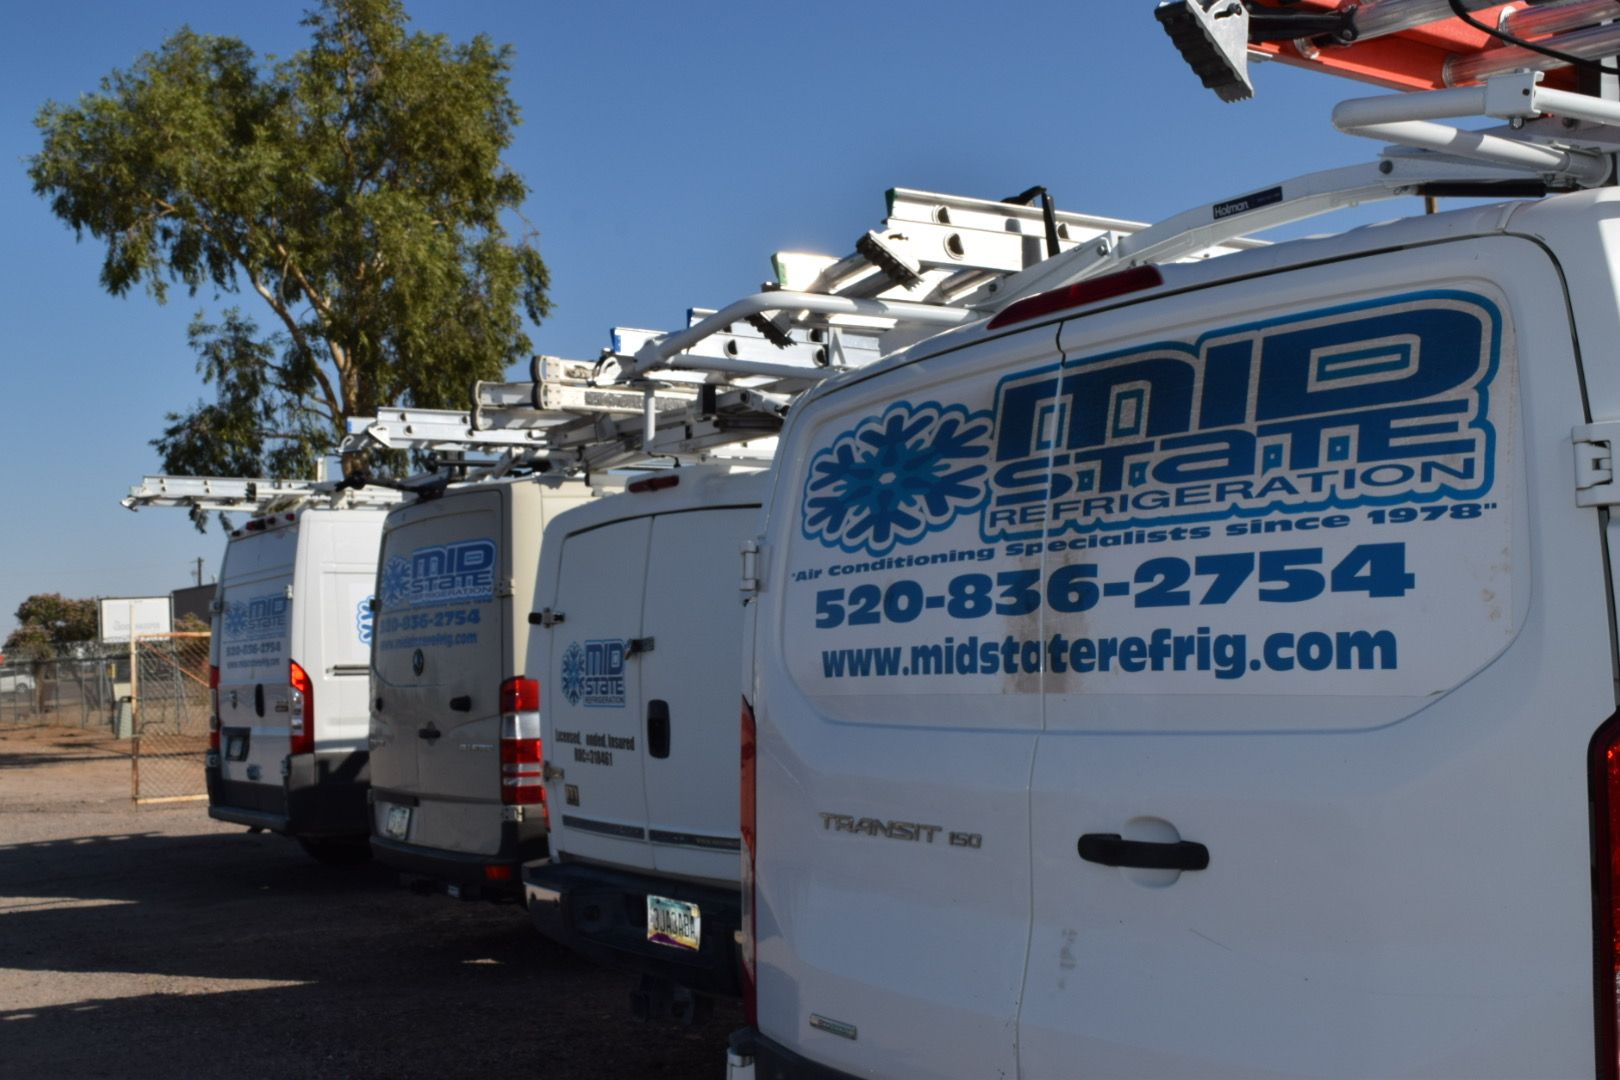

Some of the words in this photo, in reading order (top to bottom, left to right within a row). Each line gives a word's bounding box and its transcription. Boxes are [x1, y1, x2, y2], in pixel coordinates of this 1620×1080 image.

[1214, 201, 1250, 218] Holman
[988, 457, 1475, 529] REFRIGERATION
[828, 547, 996, 577] Conditioning
[1005, 526, 1212, 557] Specialists
[1225, 514, 1351, 537] since
[1366, 502, 1498, 526] 1978"
[814, 541, 1416, 630] 520-836-2754
[821, 626, 1398, 680] www.midstaterefrig.com
[817, 811, 943, 843] TRANSIT
[948, 830, 983, 849] 150
